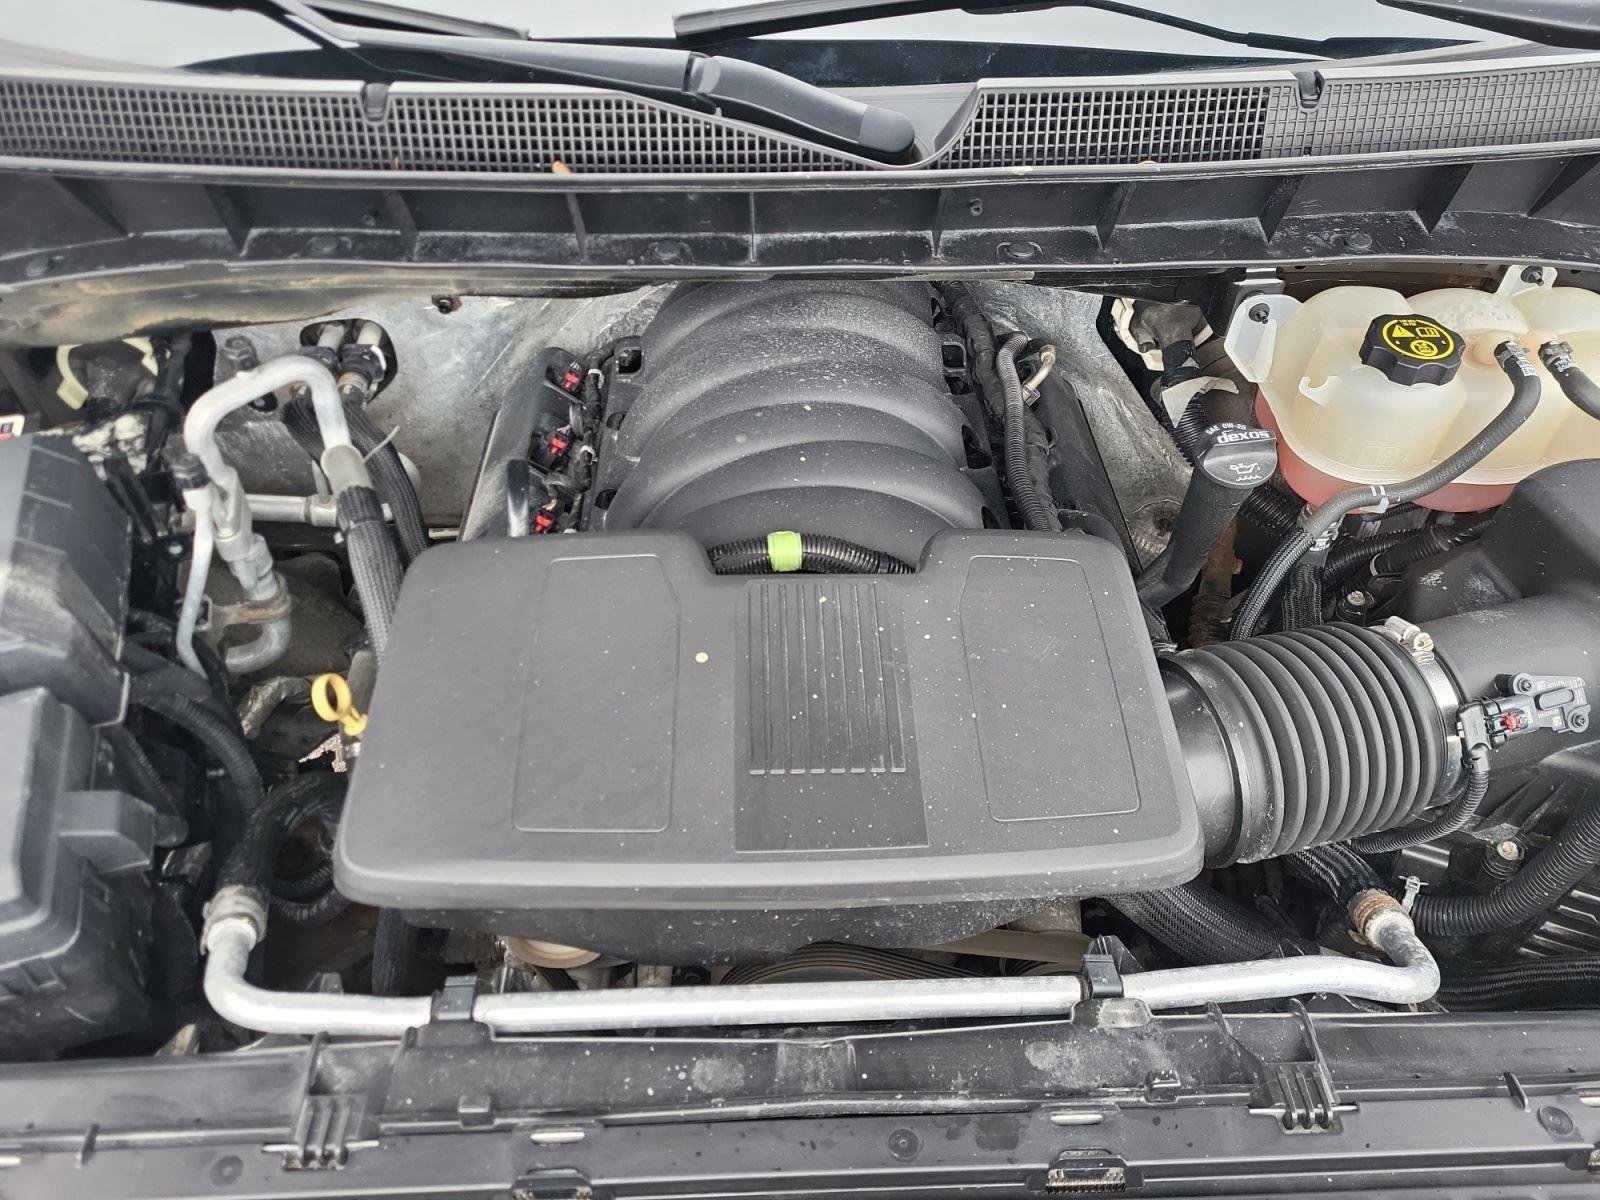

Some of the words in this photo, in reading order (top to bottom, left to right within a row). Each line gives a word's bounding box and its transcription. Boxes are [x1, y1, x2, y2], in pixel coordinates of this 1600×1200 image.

[1205, 425, 1220, 435] SAE
[1222, 422, 1247, 431] 0W-20
[1217, 430, 1270, 444] dexos
